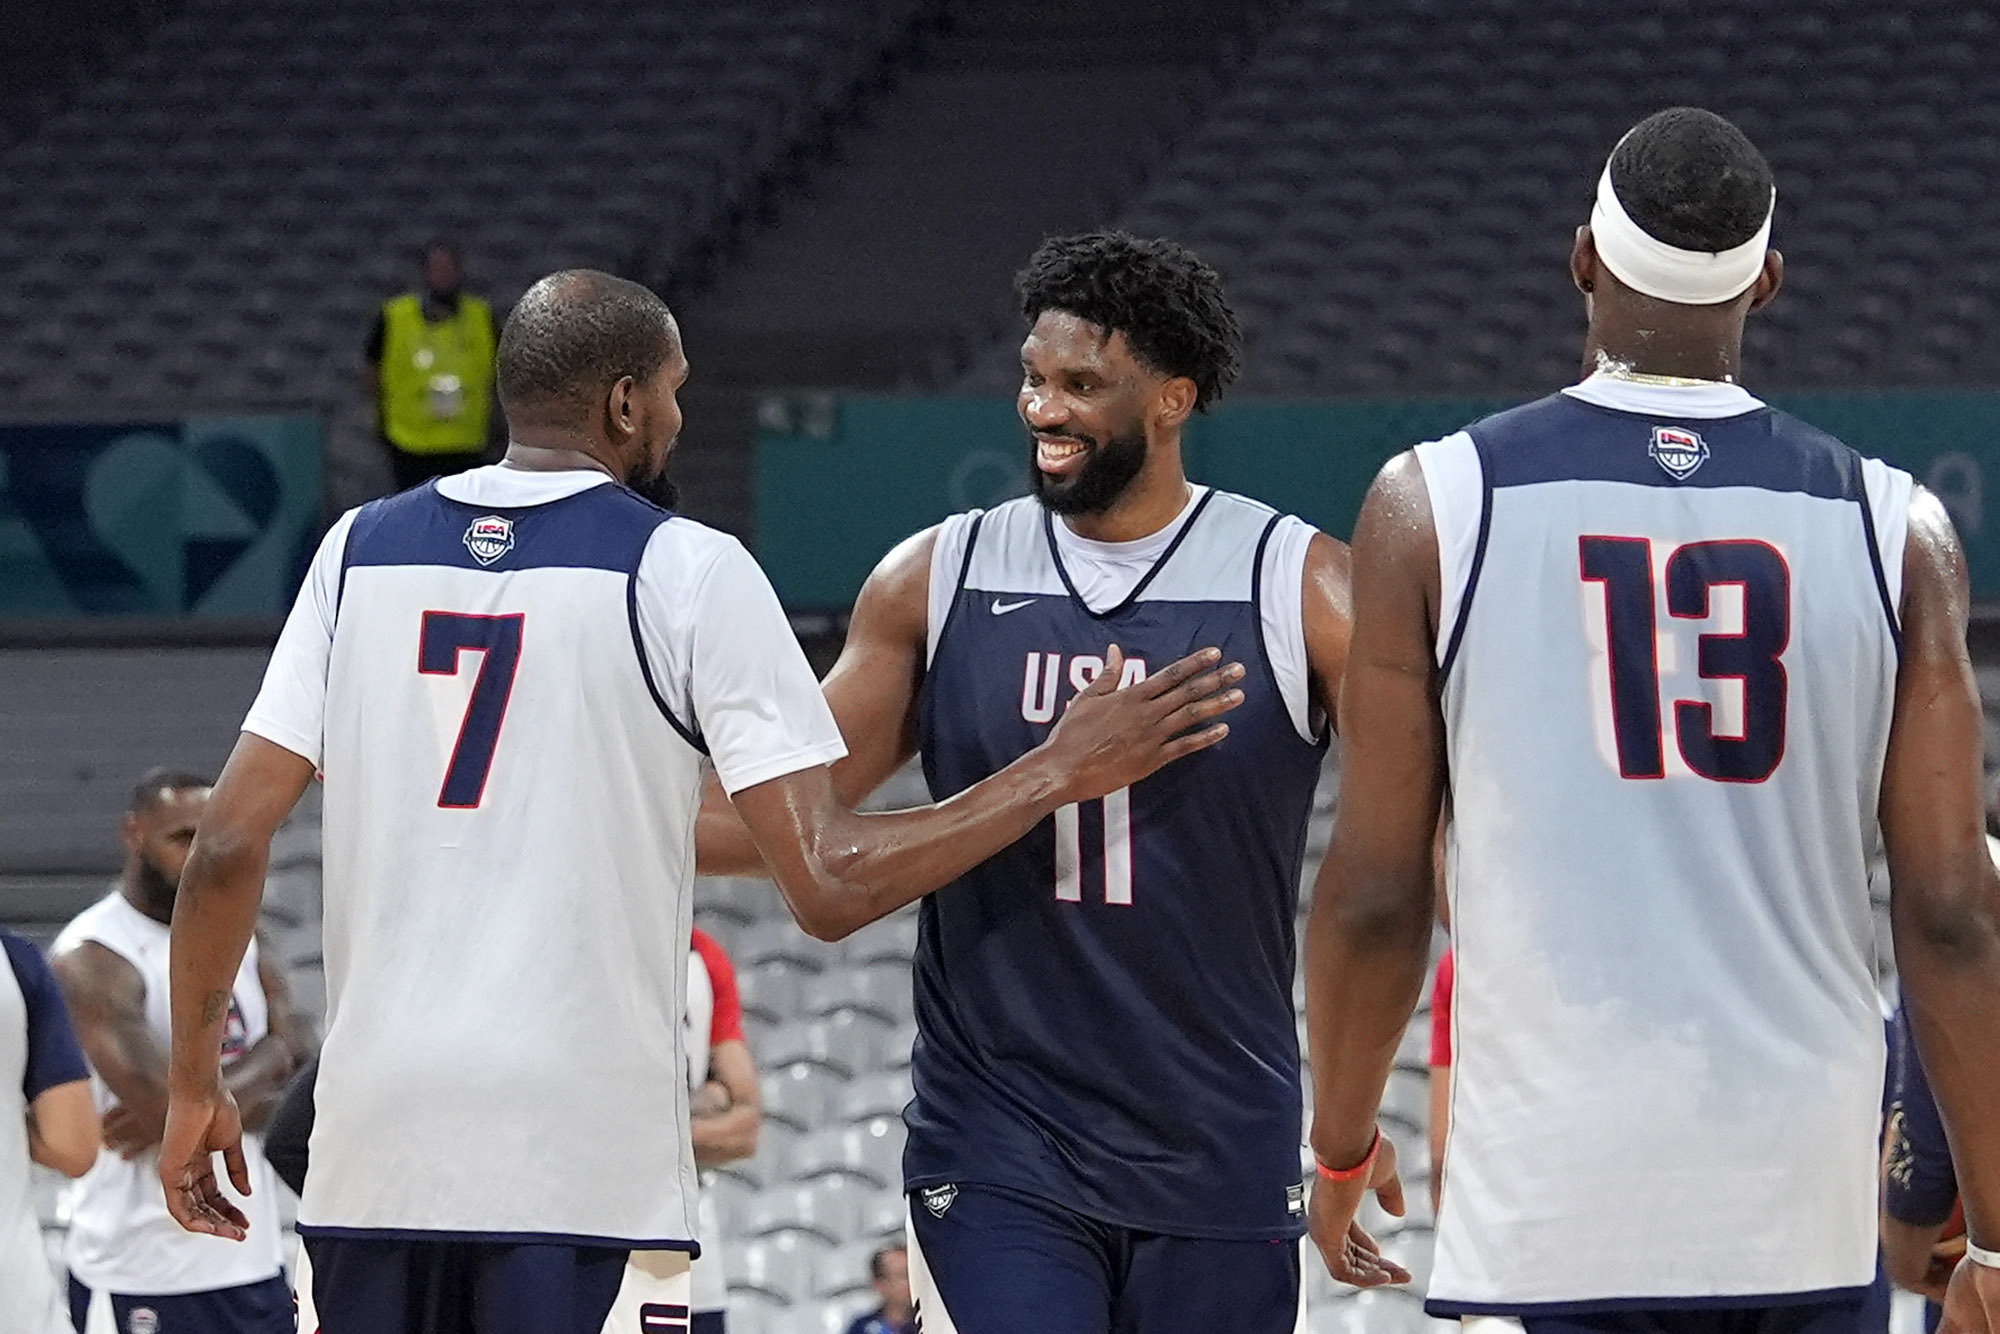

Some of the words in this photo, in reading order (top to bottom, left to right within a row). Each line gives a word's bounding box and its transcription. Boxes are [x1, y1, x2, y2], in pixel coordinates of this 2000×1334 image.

[476, 524, 505, 537] USA
[418, 610, 525, 809] 7
[1579, 535, 1790, 784] 13
[1055, 785, 1133, 906] 11
